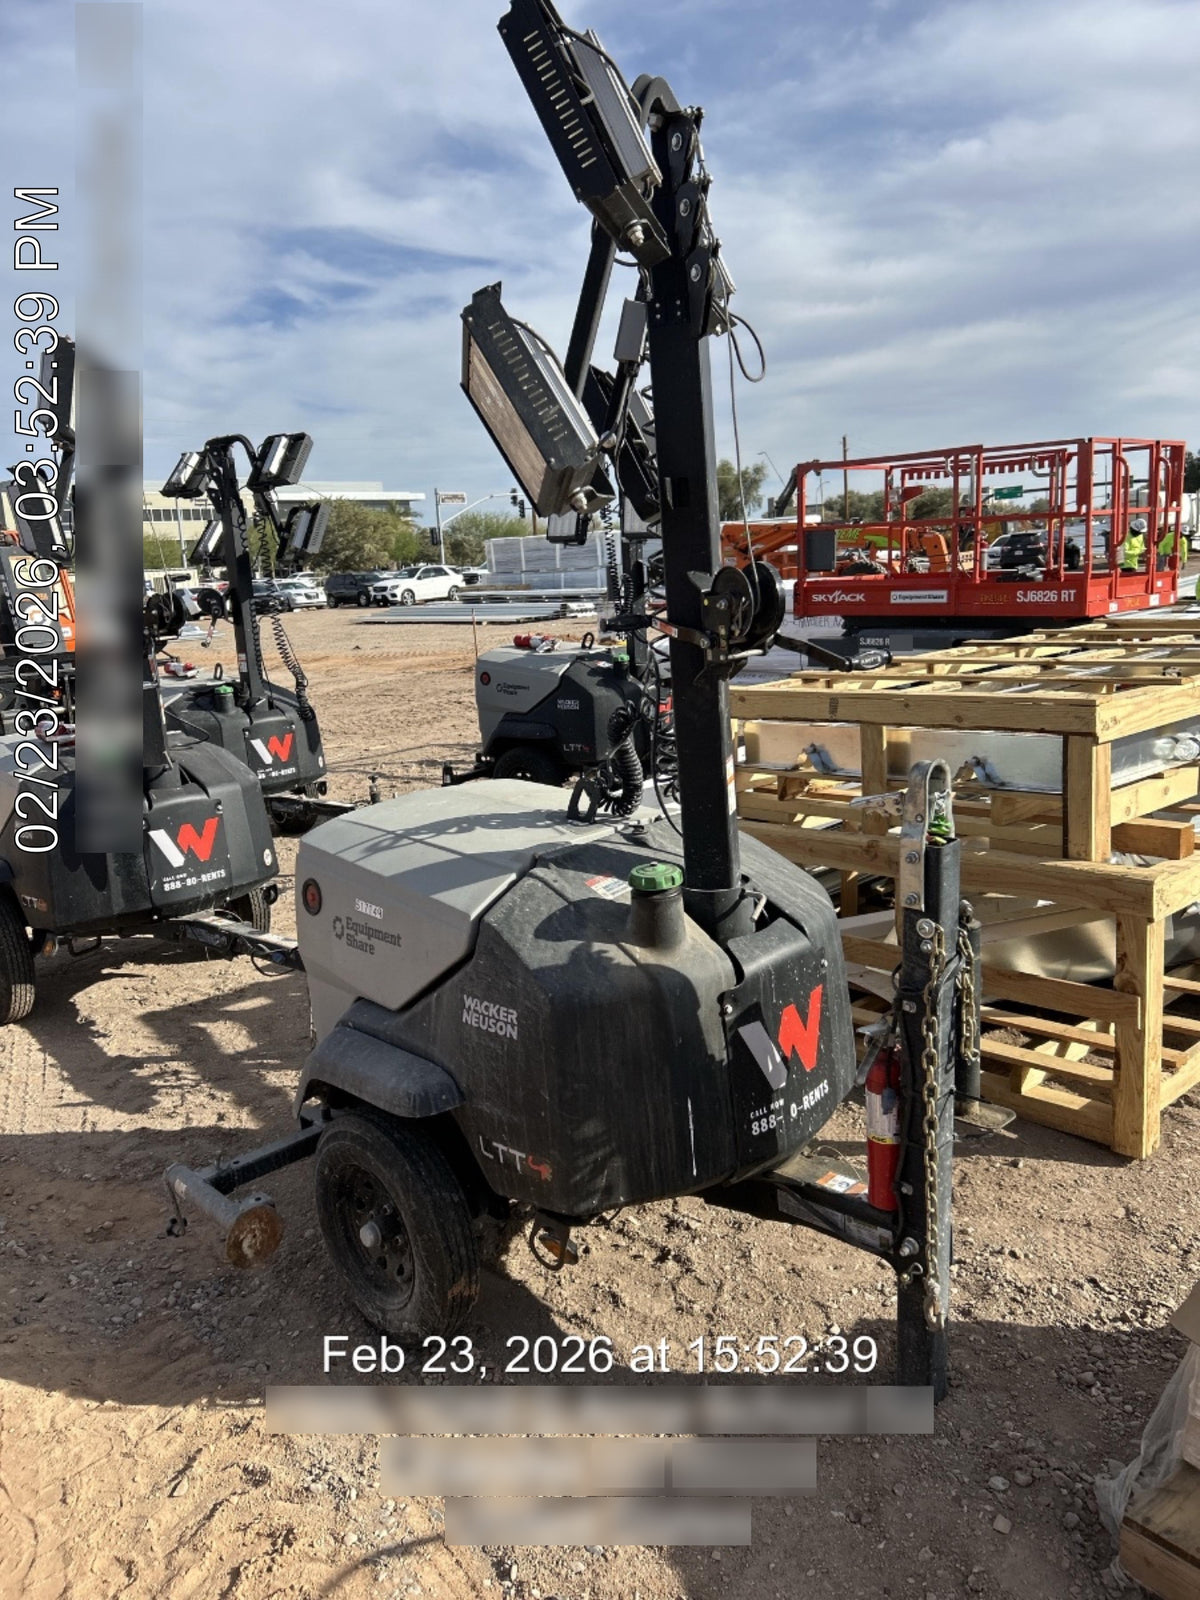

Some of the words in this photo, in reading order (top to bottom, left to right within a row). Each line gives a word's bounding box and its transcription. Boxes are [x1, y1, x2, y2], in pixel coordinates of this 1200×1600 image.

[812, 589, 866, 604] SKYJACK
[1016, 590, 1058, 602] SJ6826
[1061, 590, 1077, 602] RT
[345, 916, 402, 948] Equipment
[345, 933, 375, 955] Share
[462, 994, 518, 1025] WACKER
[462, 1009, 518, 1041] NEUSON
[749, 1106, 768, 1119] CALL
